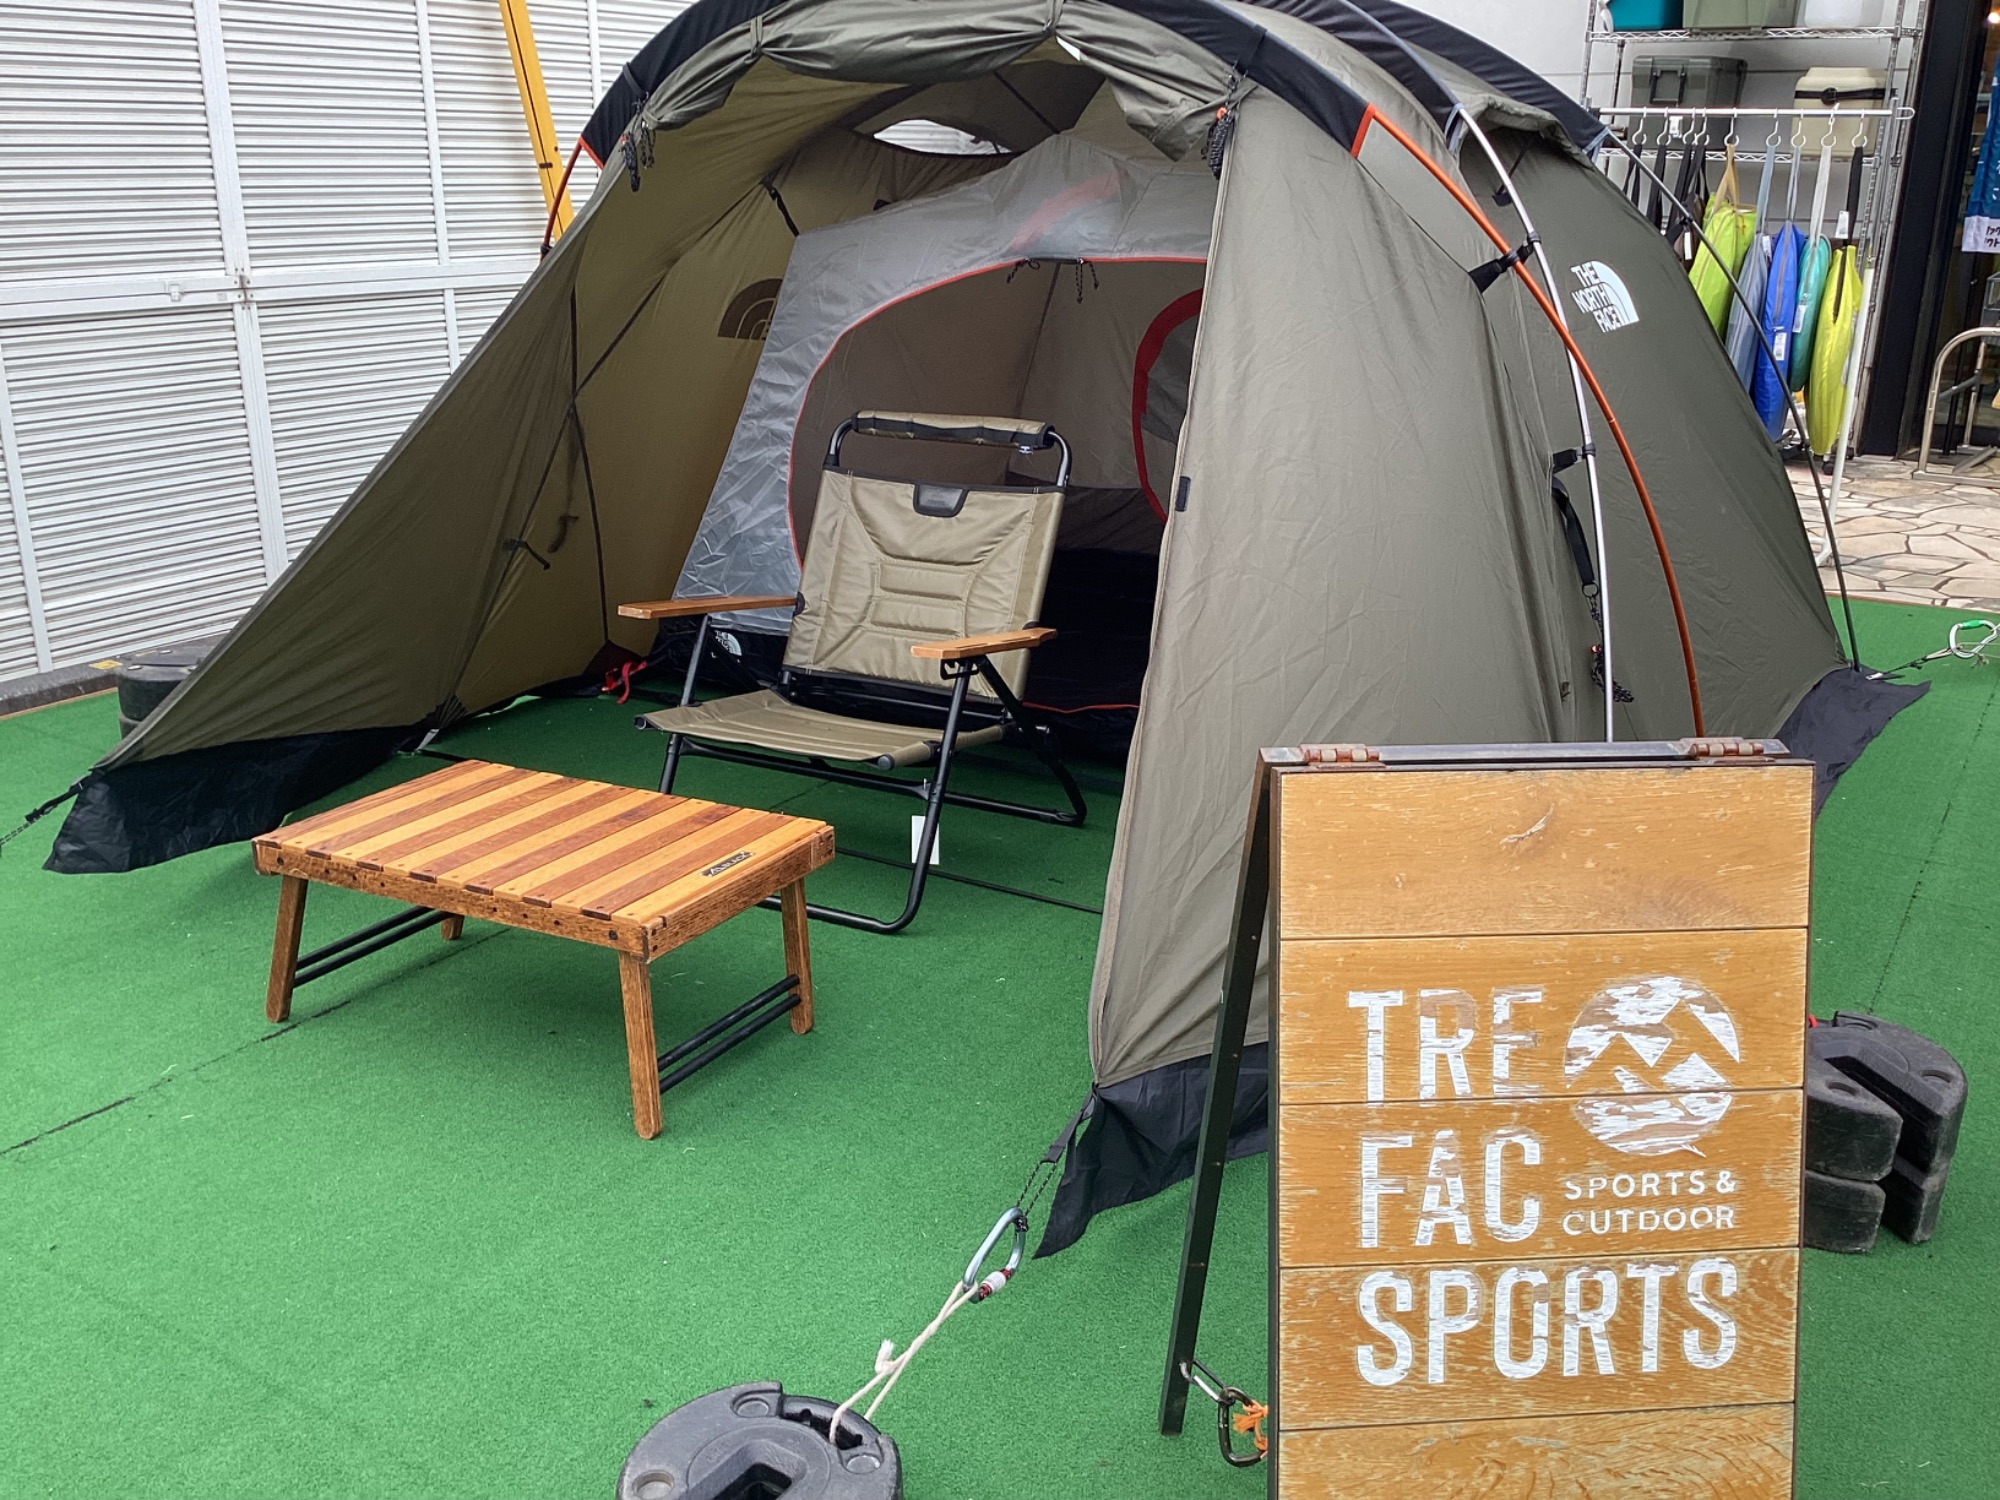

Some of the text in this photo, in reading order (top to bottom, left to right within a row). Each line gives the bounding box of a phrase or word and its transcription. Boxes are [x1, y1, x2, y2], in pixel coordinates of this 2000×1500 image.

[1570, 261, 1600, 288] THE
[1571, 283, 1612, 313] NORTH
[1592, 304, 1622, 333] FACE
[1347, 985, 1544, 1107] TRE
[1358, 1126, 1542, 1248] FAC
[1565, 1170, 1736, 1200] SPORTS &
[1356, 1257, 1738, 1387] SPORTS
